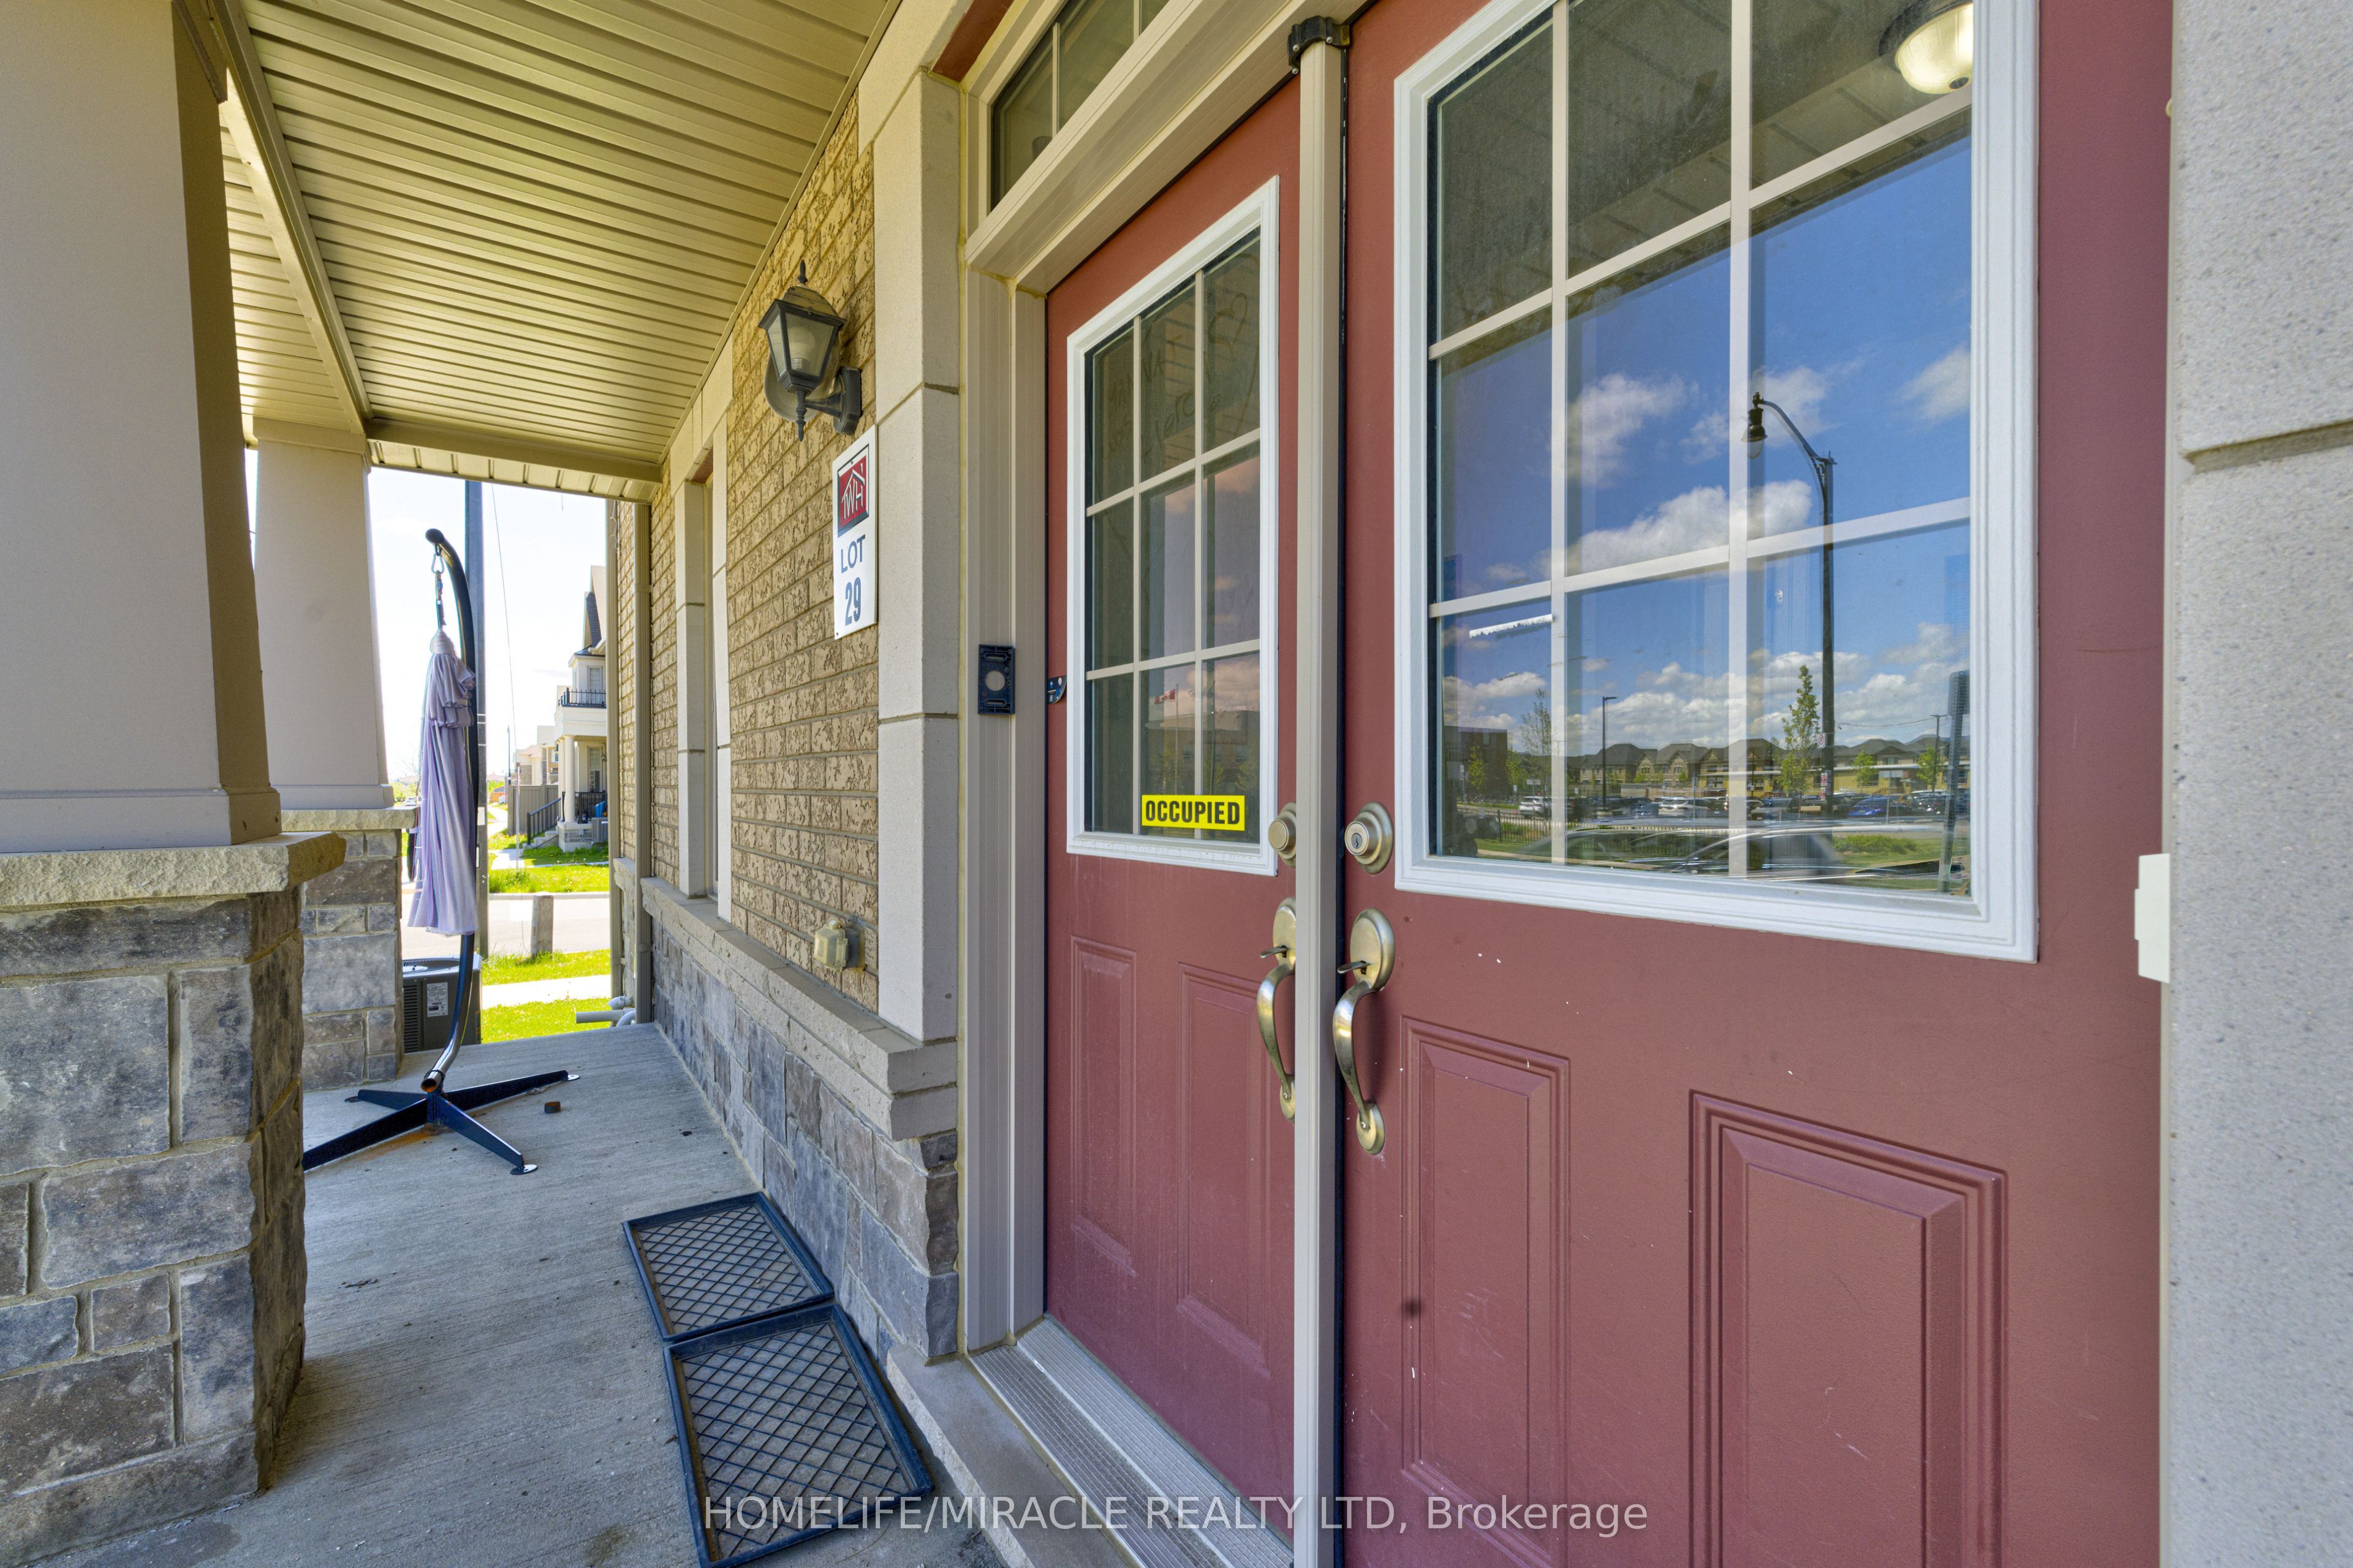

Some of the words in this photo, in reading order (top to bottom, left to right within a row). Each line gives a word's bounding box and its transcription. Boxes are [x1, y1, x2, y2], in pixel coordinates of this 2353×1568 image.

[841, 534, 866, 574] LOT
[845, 577, 862, 626] 29
[1145, 800, 1240, 825] OCCUPIED
